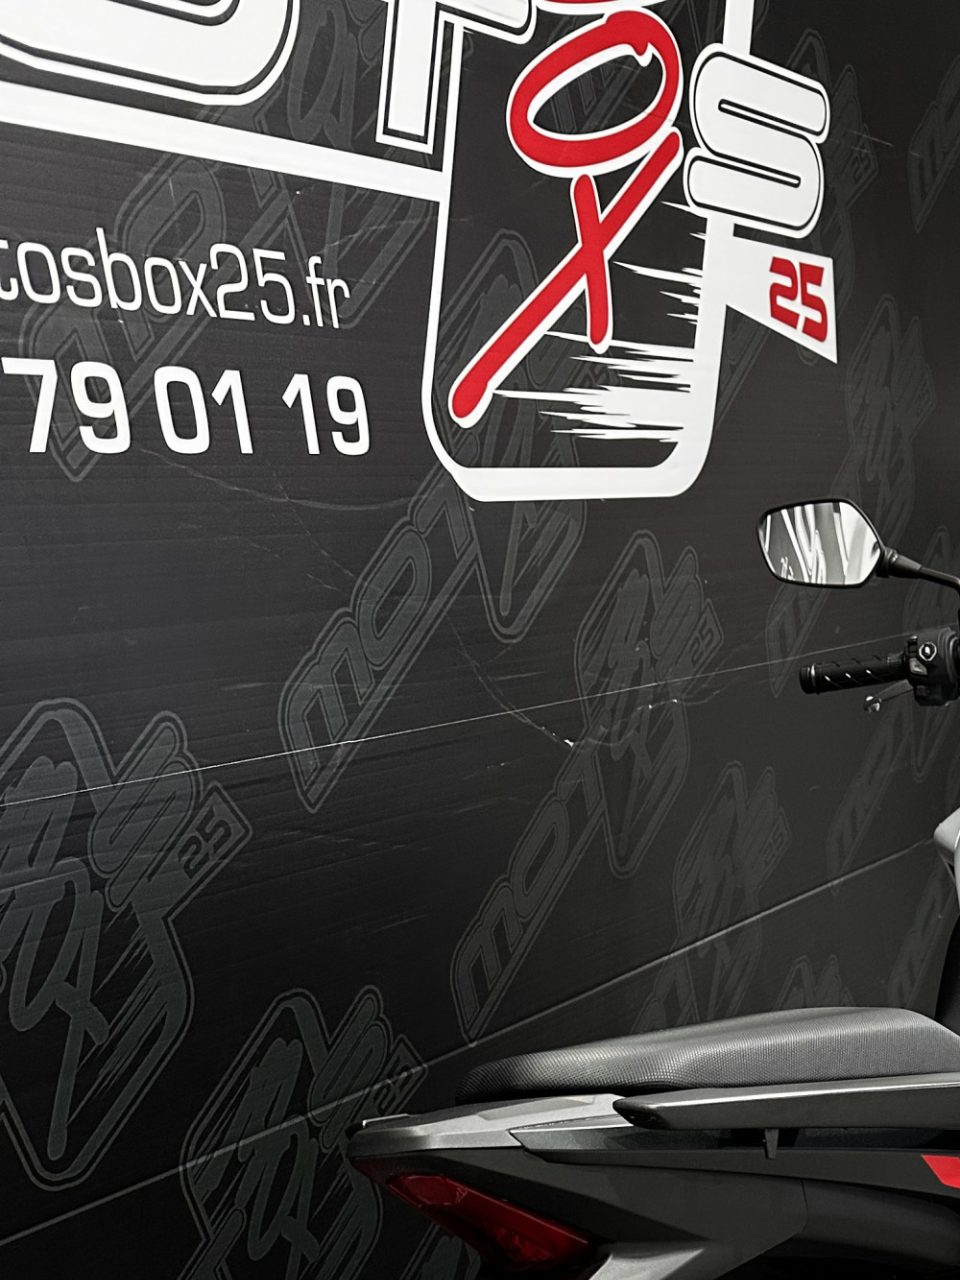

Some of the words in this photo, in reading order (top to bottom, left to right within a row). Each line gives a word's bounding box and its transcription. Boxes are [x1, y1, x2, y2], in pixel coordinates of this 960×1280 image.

[769, 256, 829, 343] 25
[1, 357, 131, 454] 79
[153, 365, 253, 454] 01
[282, 373, 370, 456] 19
